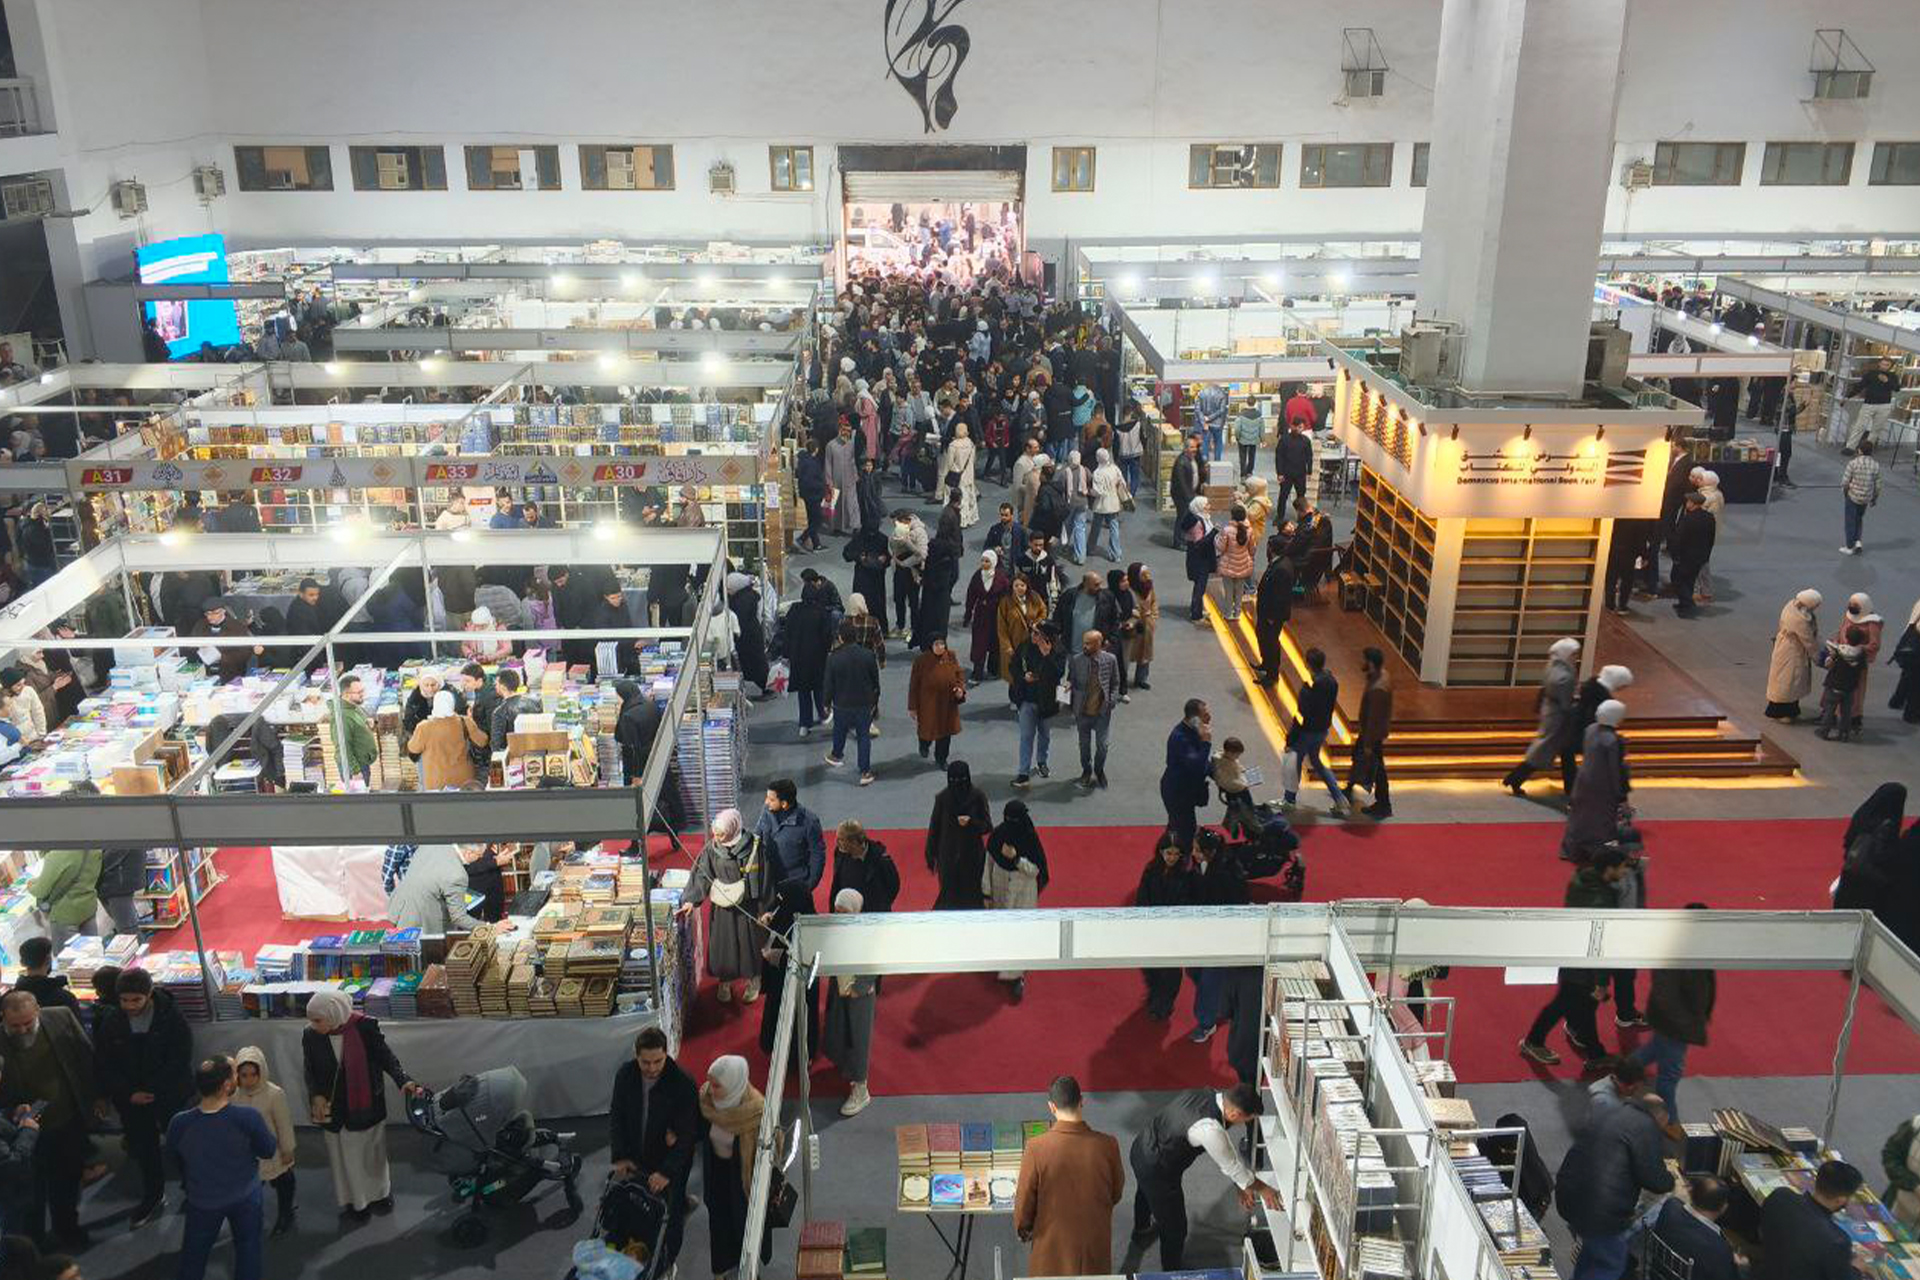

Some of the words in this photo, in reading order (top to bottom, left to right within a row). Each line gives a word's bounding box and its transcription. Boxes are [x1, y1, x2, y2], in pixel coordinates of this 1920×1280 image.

[92, 470, 122, 483] A31
[261, 469, 293, 482] A32
[436, 465, 468, 479] A33
[604, 465, 635, 479] A30
[1457, 477, 1499, 485] Damascus
[1501, 477, 1557, 485] International
[1558, 476, 1579, 485] Book
[1581, 477, 1596, 485] Fair
